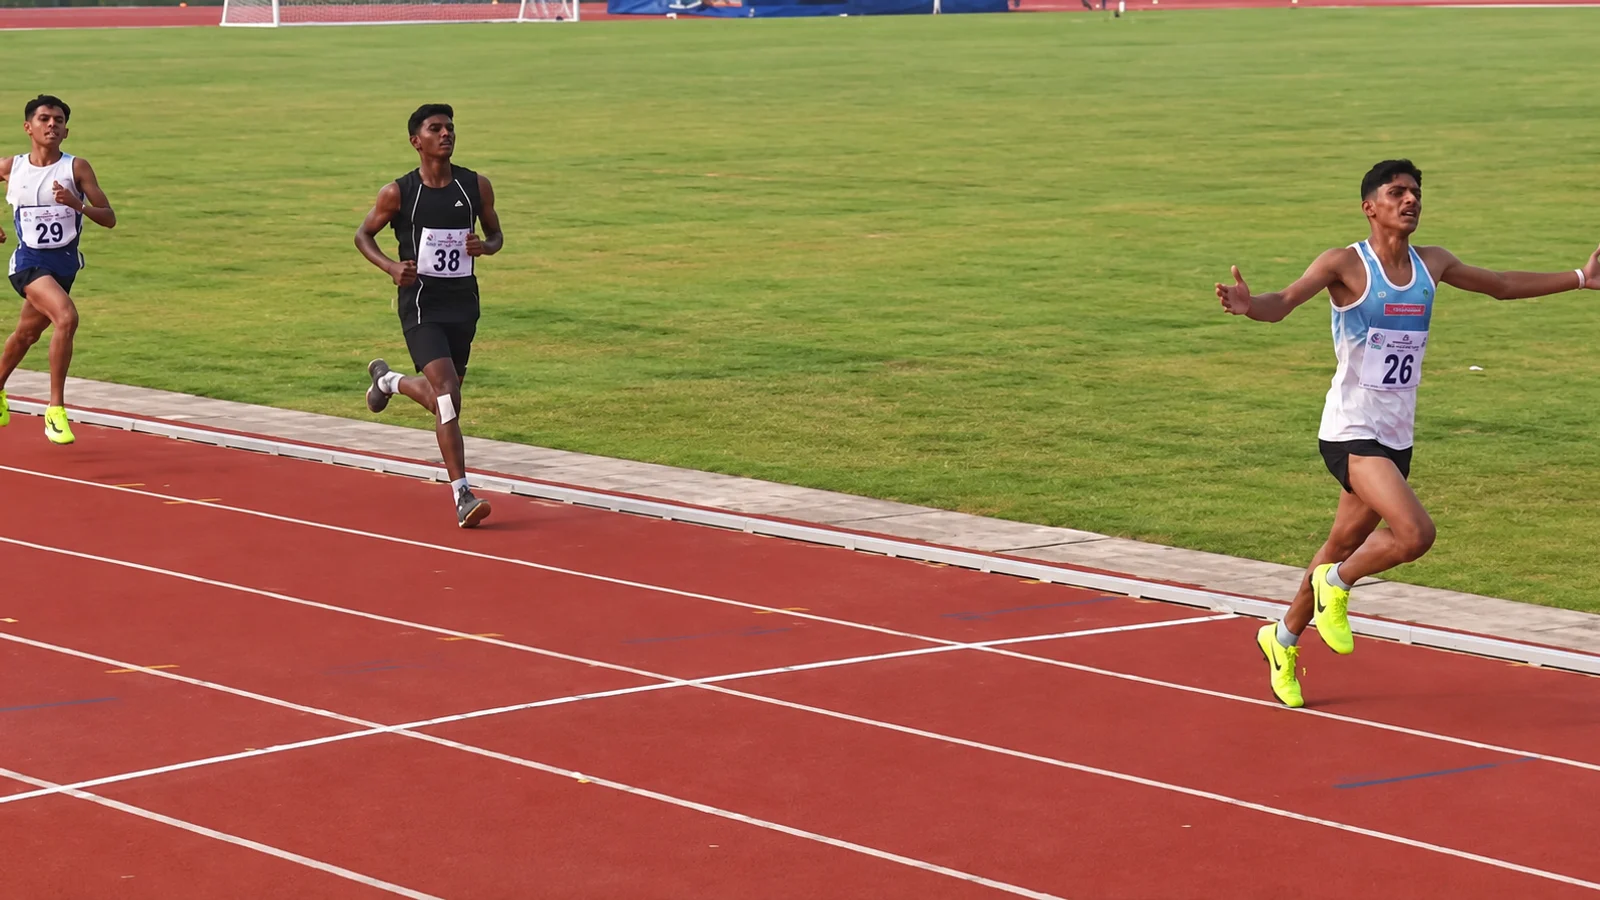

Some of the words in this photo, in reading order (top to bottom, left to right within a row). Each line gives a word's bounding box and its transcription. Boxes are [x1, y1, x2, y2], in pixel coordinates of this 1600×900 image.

[36, 222, 63, 244] 29
[433, 249, 460, 271] 38
[1382, 354, 1414, 384] 26
